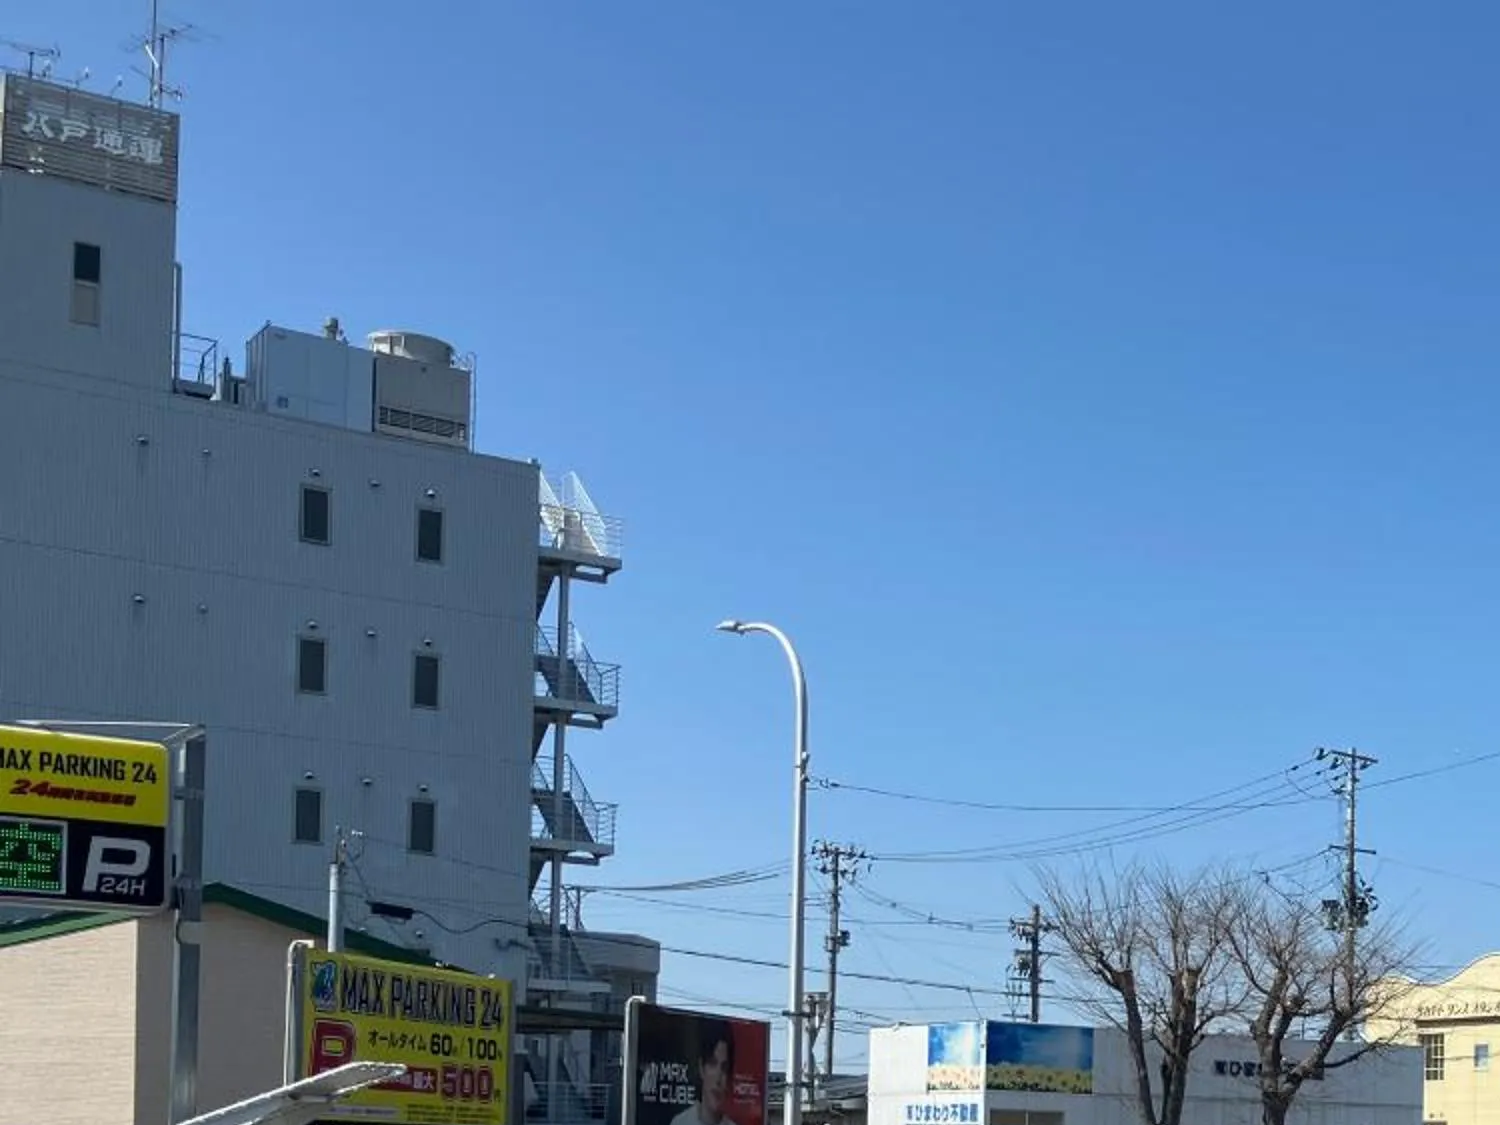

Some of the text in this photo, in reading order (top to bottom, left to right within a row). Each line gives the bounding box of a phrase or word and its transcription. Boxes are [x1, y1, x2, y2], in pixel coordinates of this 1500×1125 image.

[39, 751, 126, 781] PARKING
[132, 761, 157, 784] 24
[82, 836, 150, 892] P
[100, 877, 145, 896] 24H
[341, 964, 503, 1032] MAX PARKING 24
[659, 1062, 689, 1082] MAX
[659, 1084, 696, 1104] CUBE
